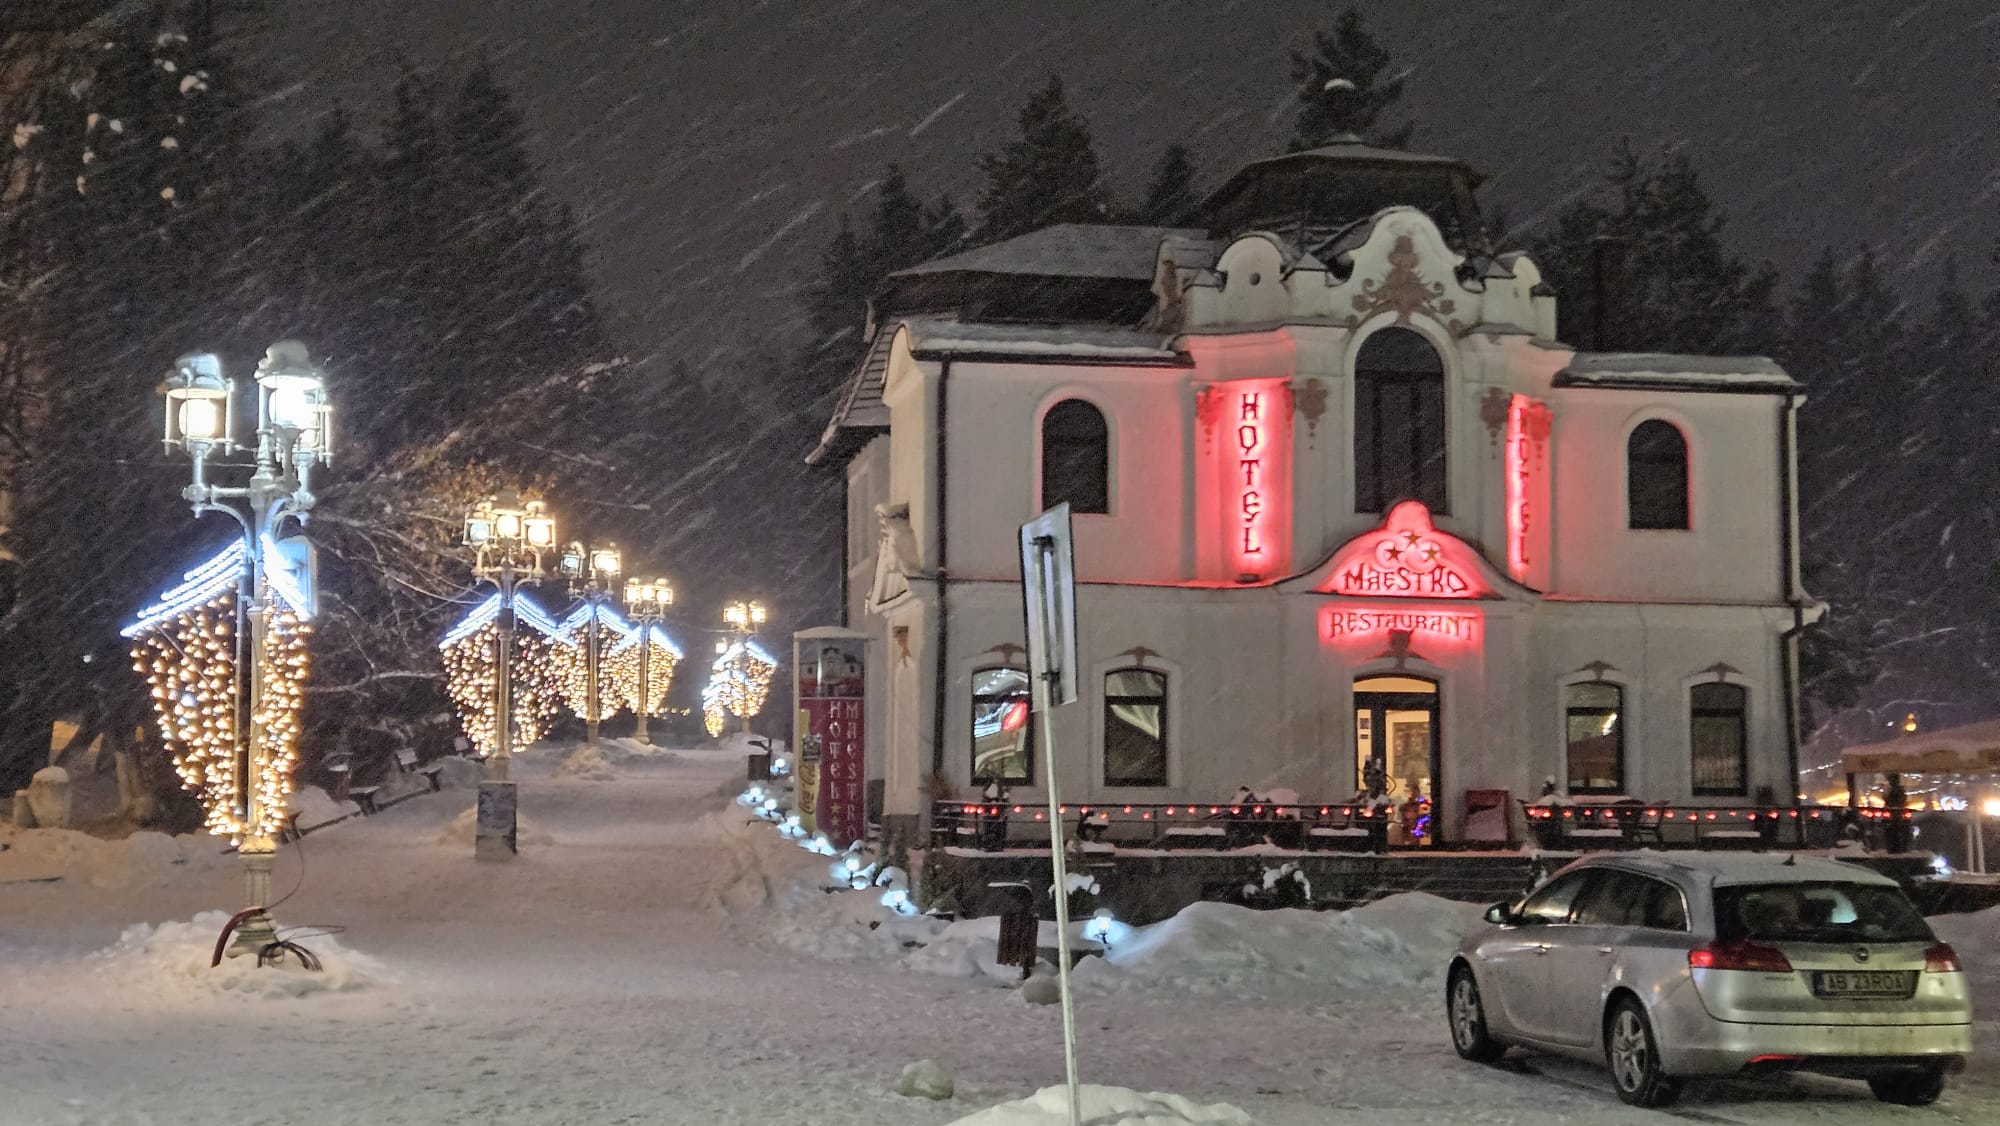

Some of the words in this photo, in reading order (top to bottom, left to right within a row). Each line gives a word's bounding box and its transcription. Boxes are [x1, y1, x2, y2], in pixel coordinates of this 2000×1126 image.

[1238, 393, 1261, 554] HOTEL
[1343, 562, 1468, 593] MAESTRO
[1329, 611, 1477, 641] RESTAURANT
